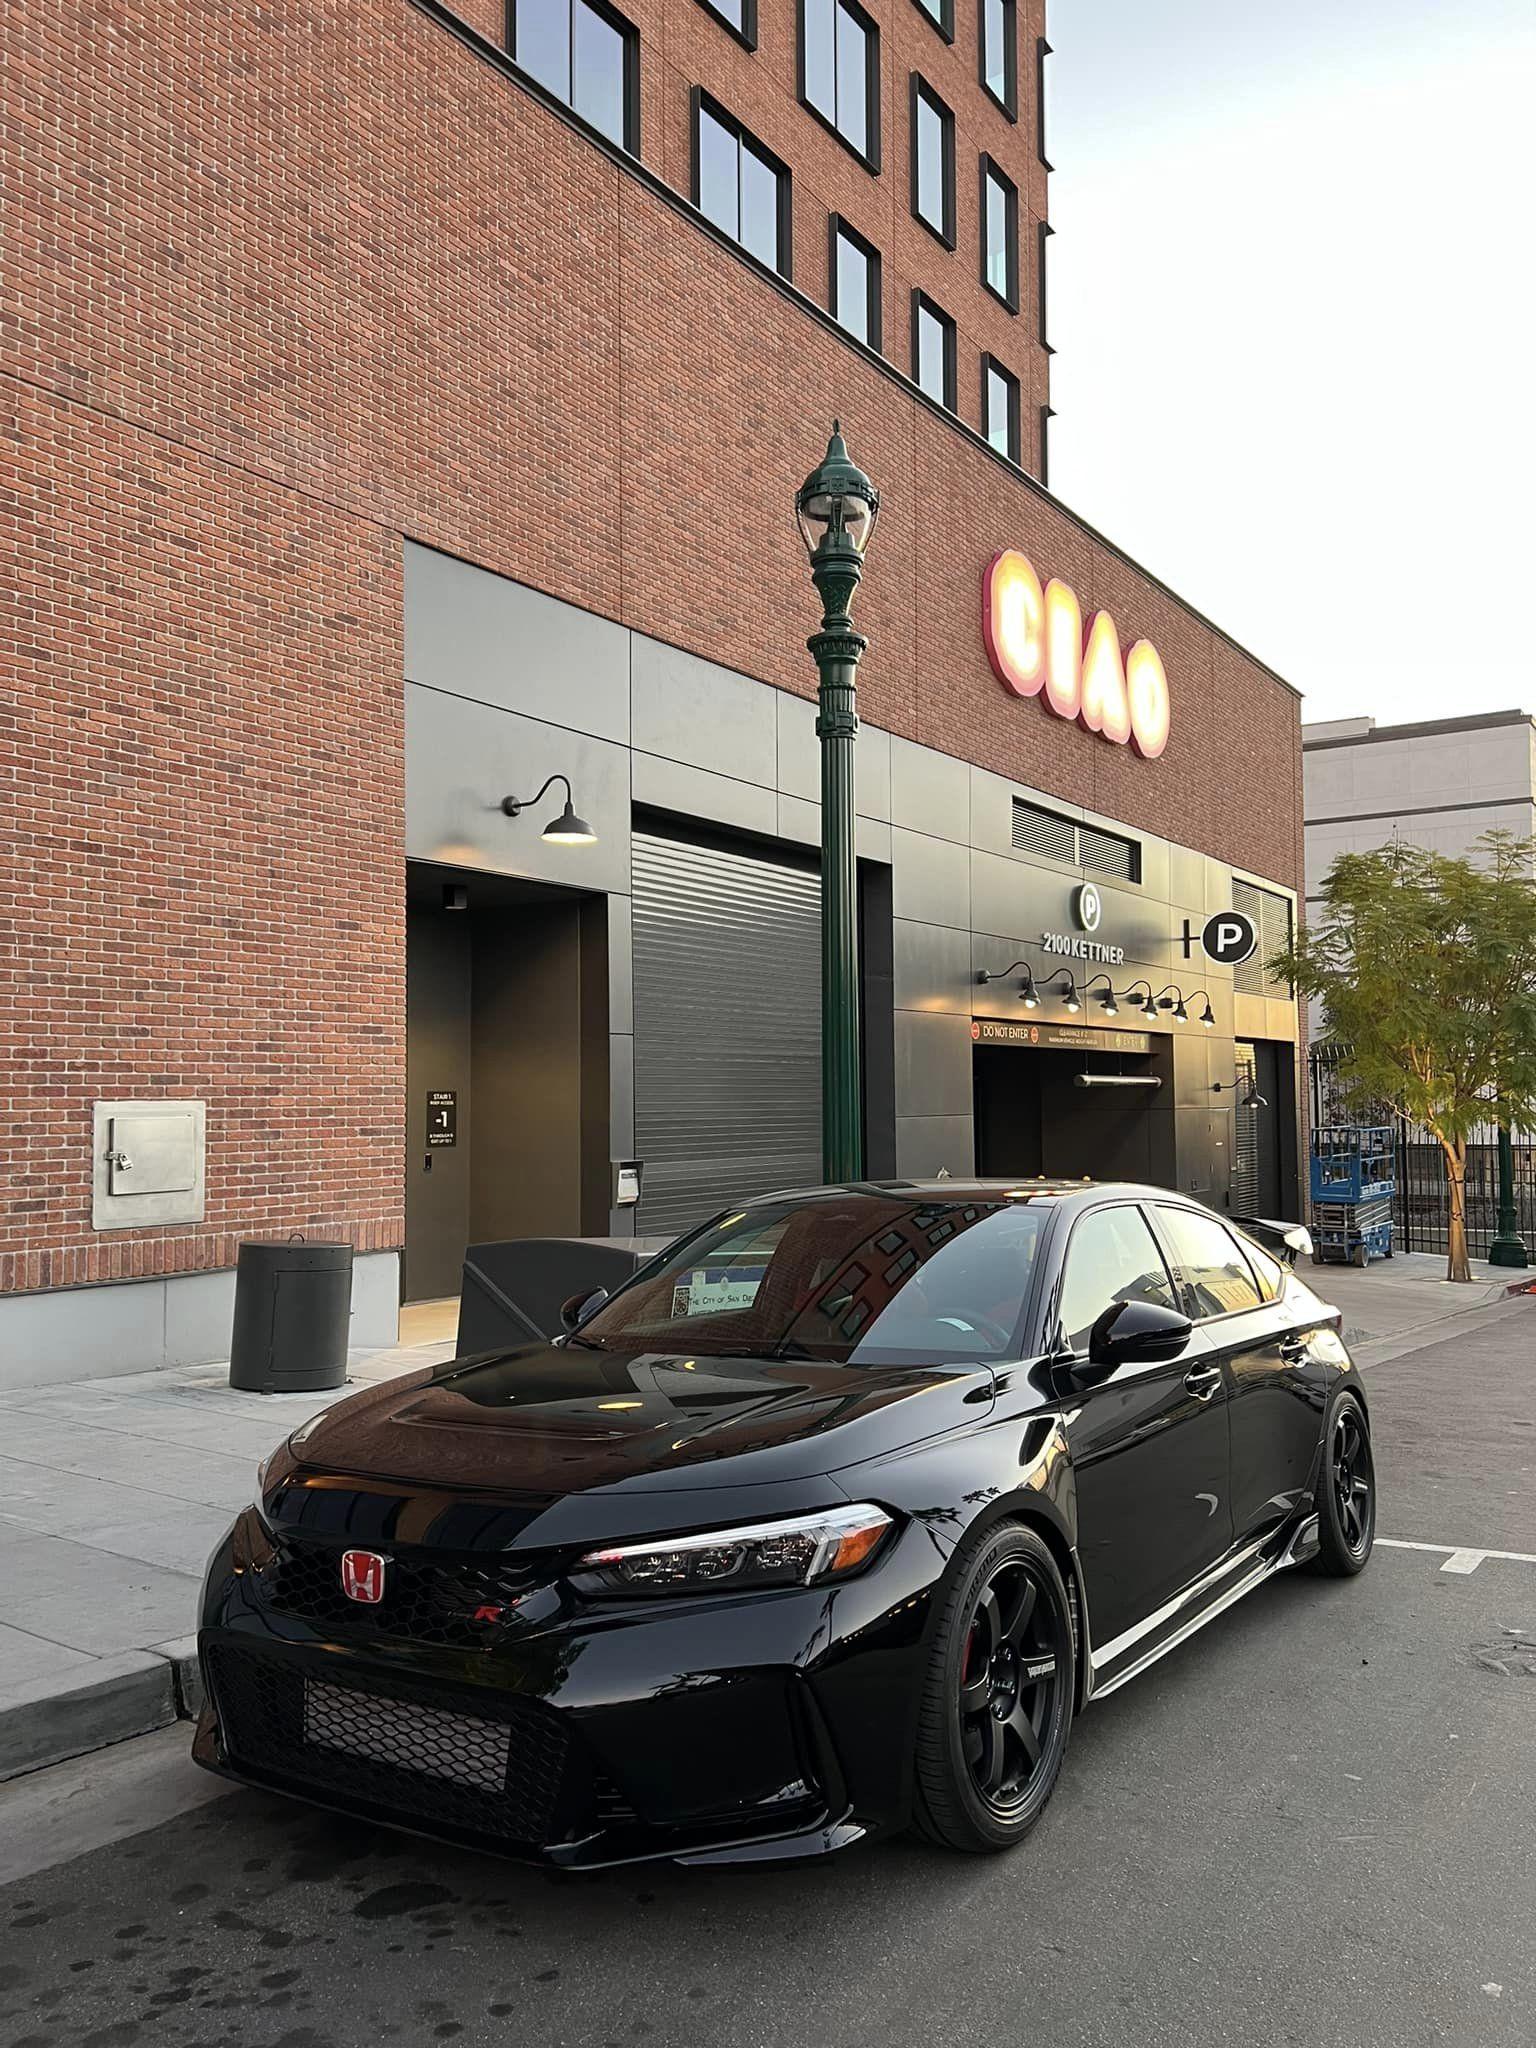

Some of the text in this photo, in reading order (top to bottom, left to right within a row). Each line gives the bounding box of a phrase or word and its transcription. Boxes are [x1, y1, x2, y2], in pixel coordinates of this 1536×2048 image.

[984, 549, 1170, 759] CIAO
[1217, 923, 1242, 952] P
[983, 1025, 1028, 1039] DO NOT ENTER
